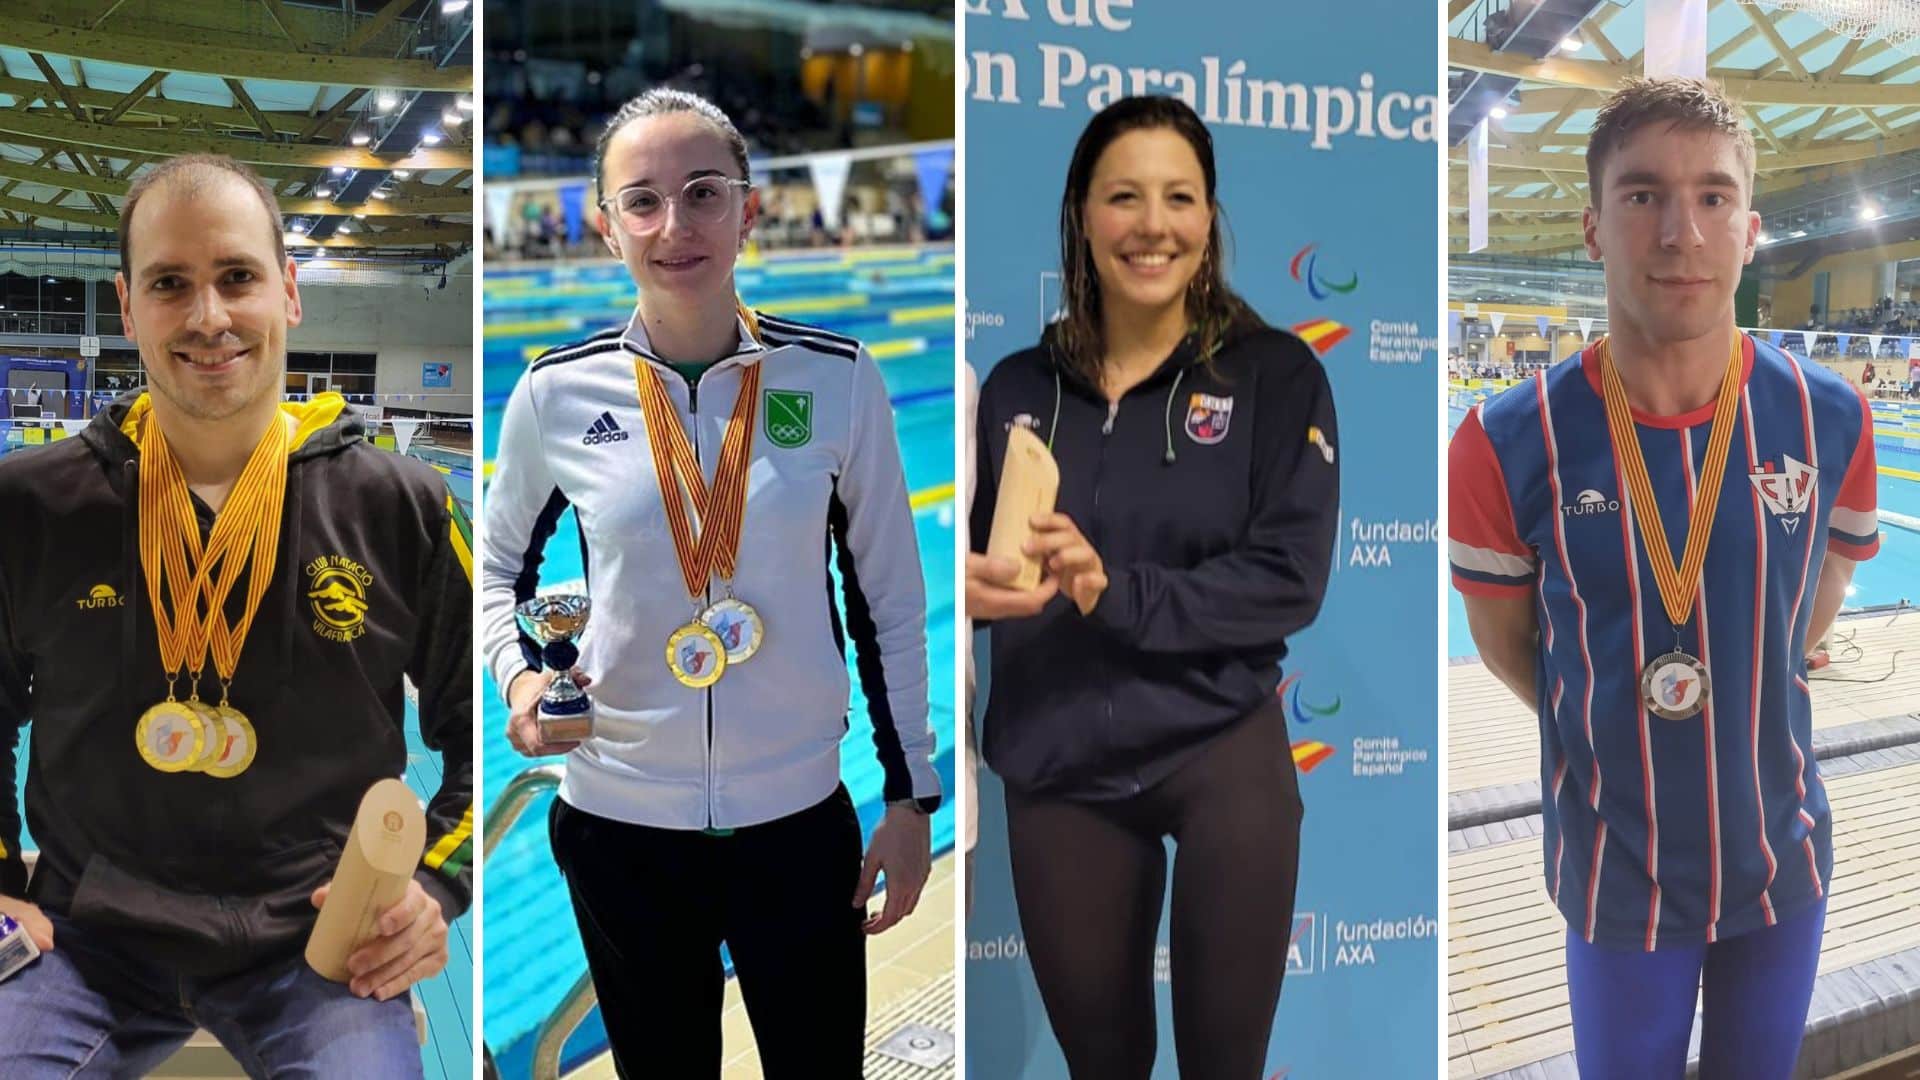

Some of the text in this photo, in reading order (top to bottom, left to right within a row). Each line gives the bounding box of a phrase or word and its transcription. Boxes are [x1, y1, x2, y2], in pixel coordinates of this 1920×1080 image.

[965, 43, 1438, 150] n Paralímpica
[582, 431, 628, 445] adidas
[1563, 501, 1619, 516] TURBO
[306, 556, 328, 576] CLUB
[1349, 544, 1392, 567] AXA
[1336, 913, 1438, 942] fundación
[1335, 943, 1376, 966] AXA
